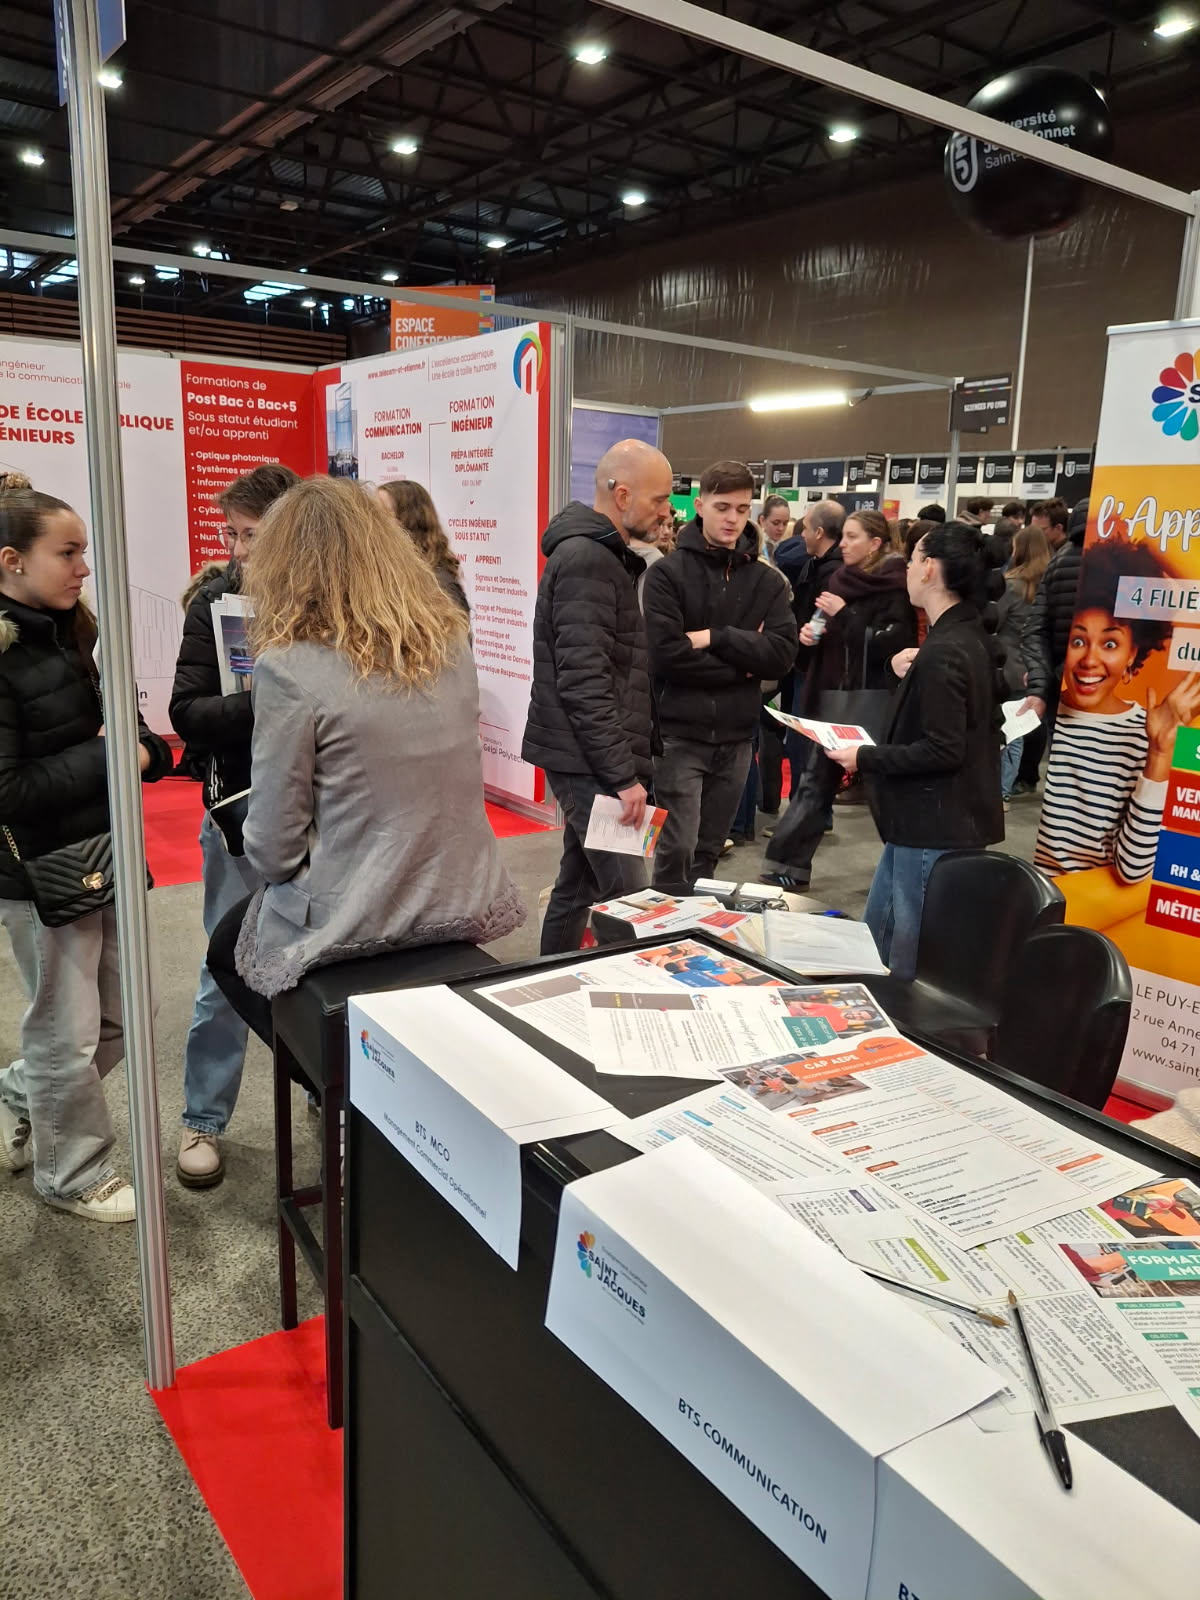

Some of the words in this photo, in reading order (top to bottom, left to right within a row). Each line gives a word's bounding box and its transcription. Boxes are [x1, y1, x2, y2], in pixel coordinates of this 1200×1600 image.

[395, 317, 435, 333] ESPACE
[461, 348, 494, 363] académique
[441, 368, 455, 380] école
[473, 361, 497, 374] humaine
[185, 373, 250, 390] Formations
[252, 379, 267, 391] de
[186, 392, 217, 406] Post
[219, 395, 244, 408] Bac
[246, 397, 254, 409] à
[257, 398, 298, 413] Bac+5
[449, 395, 495, 413] FORMATION
[26, 402, 84, 424] ÉCOLE
[187, 410, 216, 423] Sous
[218, 413, 251, 426] statut
[253, 415, 298, 429] étudiant
[374, 407, 411, 423] FORMATION
[119, 414, 175, 432] BLIQUE
[364, 422, 422, 439] COMMUNICATION
[451, 416, 493, 433] INGÉNIEUR
[188, 423, 220, 437] et/ou
[222, 428, 270, 441] apprenti
[195, 450, 231, 462] Optique
[232, 453, 280, 464] photonique
[381, 450, 405, 461] BACHELOR
[450, 448, 468, 460] PRÉPA
[468, 447, 494, 459] INTÉGRÉE
[196, 464, 238, 475] Systèmes
[454, 462, 489, 473] DIPLÔMANTE
[448, 518, 468, 528] CYCLES
[468, 517, 497, 529] INGÉNIEUR
[454, 531, 469, 541] SOUS
[469, 532, 490, 542] STATUT
[475, 554, 502, 566] APPRENTI
[1131, 587, 1143, 606] 4
[1177, 641, 1200, 662] du
[1172, 805, 1200, 822] MAN
[1170, 864, 1189, 879] RH
[1135, 983, 1153, 1000] LE
[1132, 1008, 1141, 1021] 2
[1143, 1013, 1165, 1029] rue
[1167, 1020, 1200, 1040] Anne
[1161, 1036, 1177, 1051] 04
[1181, 1042, 1196, 1057] 71
[803, 1060, 828, 1072] CAP
[414, 1119, 427, 1140] BTS
[429, 1137, 451, 1162] MCO
[415, 1142, 449, 1183] Commercial
[448, 1175, 487, 1220] Opérationnel
[597, 1272, 647, 1318] JACQUES
[678, 1397, 701, 1427] BTS
[703, 1421, 828, 1545] COMMUNICATION
